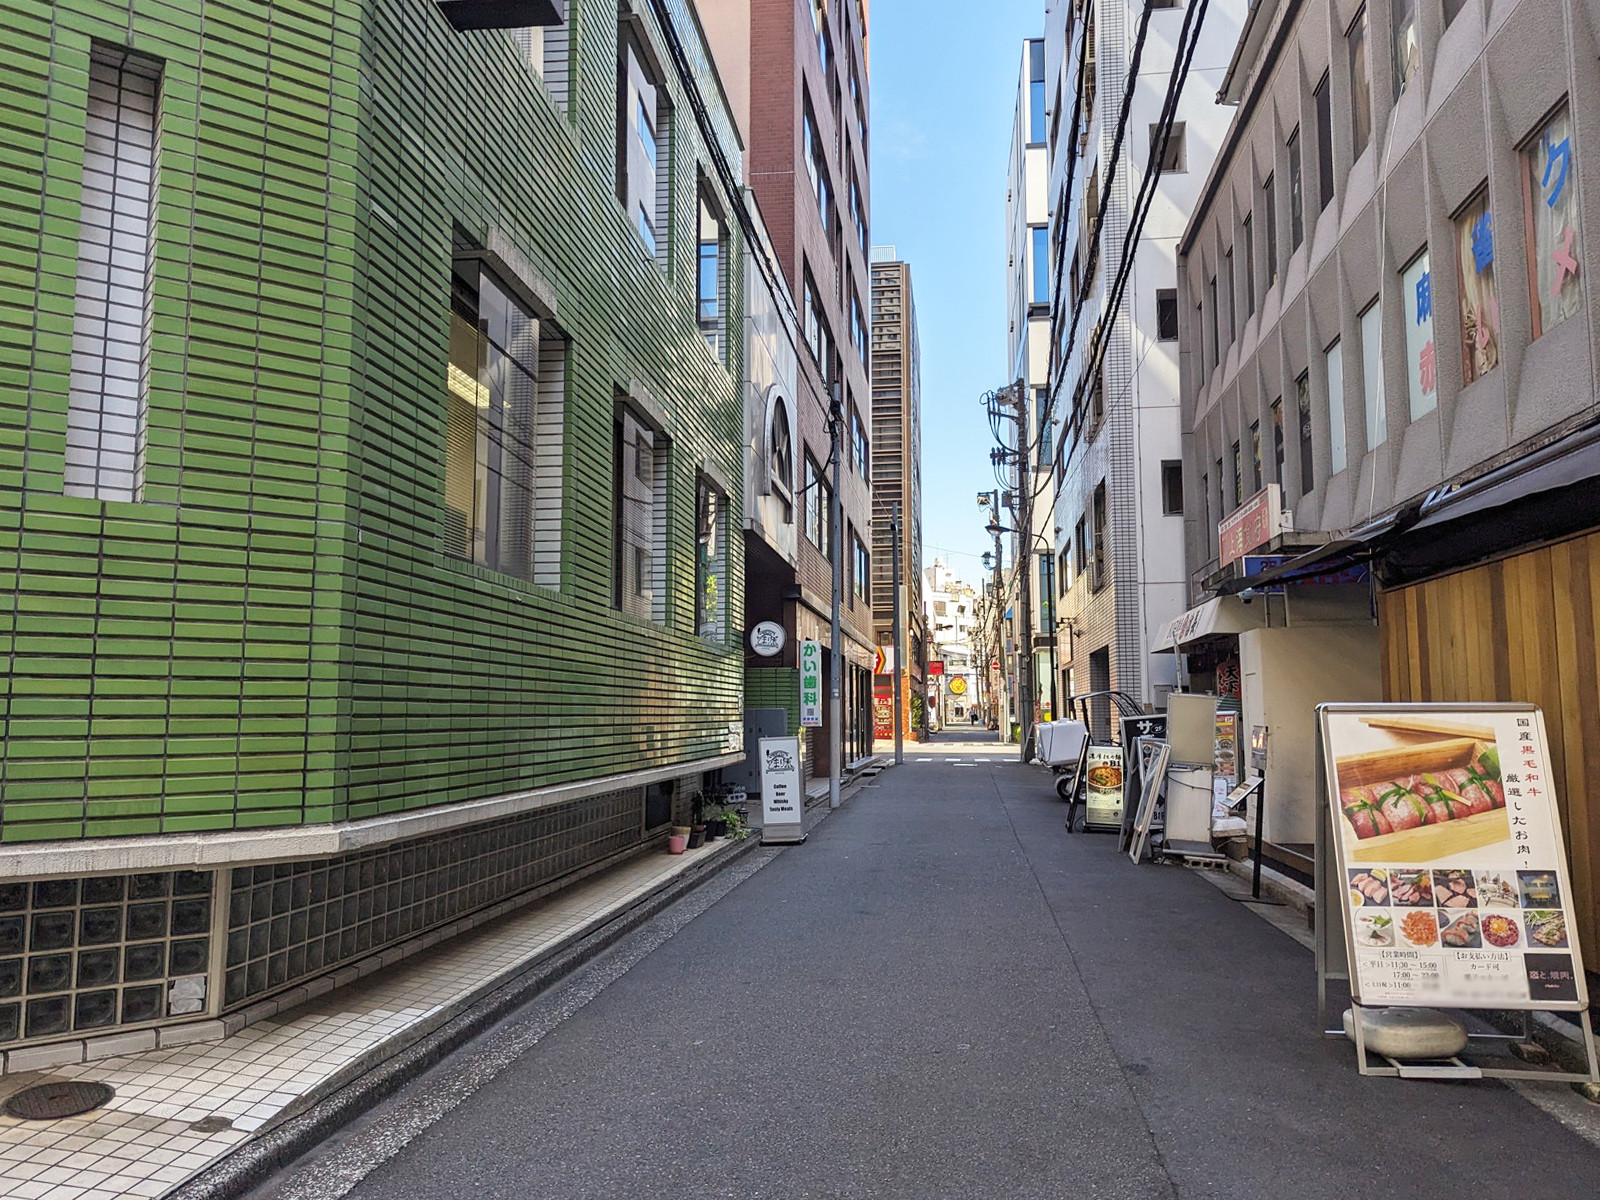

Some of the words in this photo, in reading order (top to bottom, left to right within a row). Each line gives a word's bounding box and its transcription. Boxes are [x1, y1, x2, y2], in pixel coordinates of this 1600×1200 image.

[803, 643, 817, 706] かい歯科
[1136, 720, 1153, 735] サ
[1516, 718, 1542, 797] 国産黒毛和牛
[1470, 963, 1500, 971] カード可
